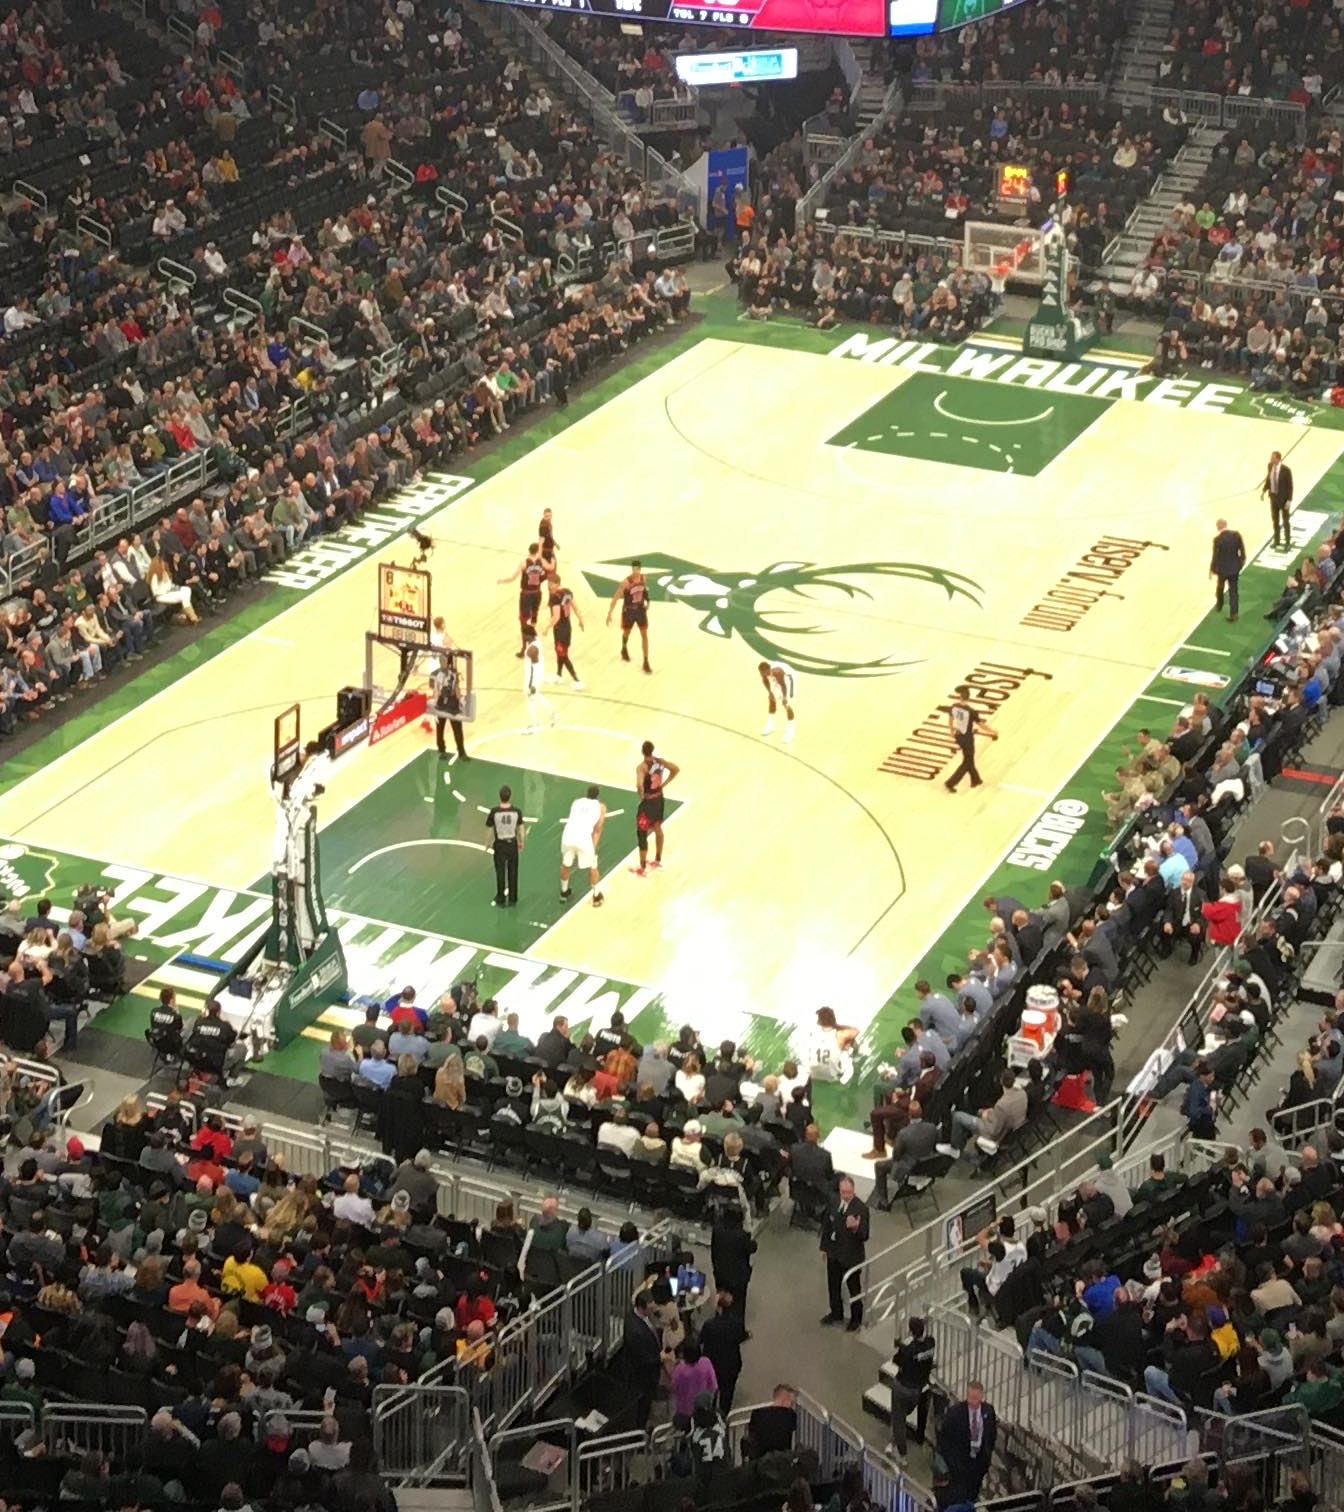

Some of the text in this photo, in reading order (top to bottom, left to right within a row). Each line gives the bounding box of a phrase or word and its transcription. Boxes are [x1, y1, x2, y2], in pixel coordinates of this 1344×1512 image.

[700, 10, 707, 21] 7
[1001, 177, 1026, 195] 24
[826, 333, 1254, 415] MILWAUKEE
[378, 471, 475, 516] FEAR
[260, 539, 367, 590] DEER
[1007, 798, 1089, 872] @BUCKS
[816, 1048, 830, 1065] 12
